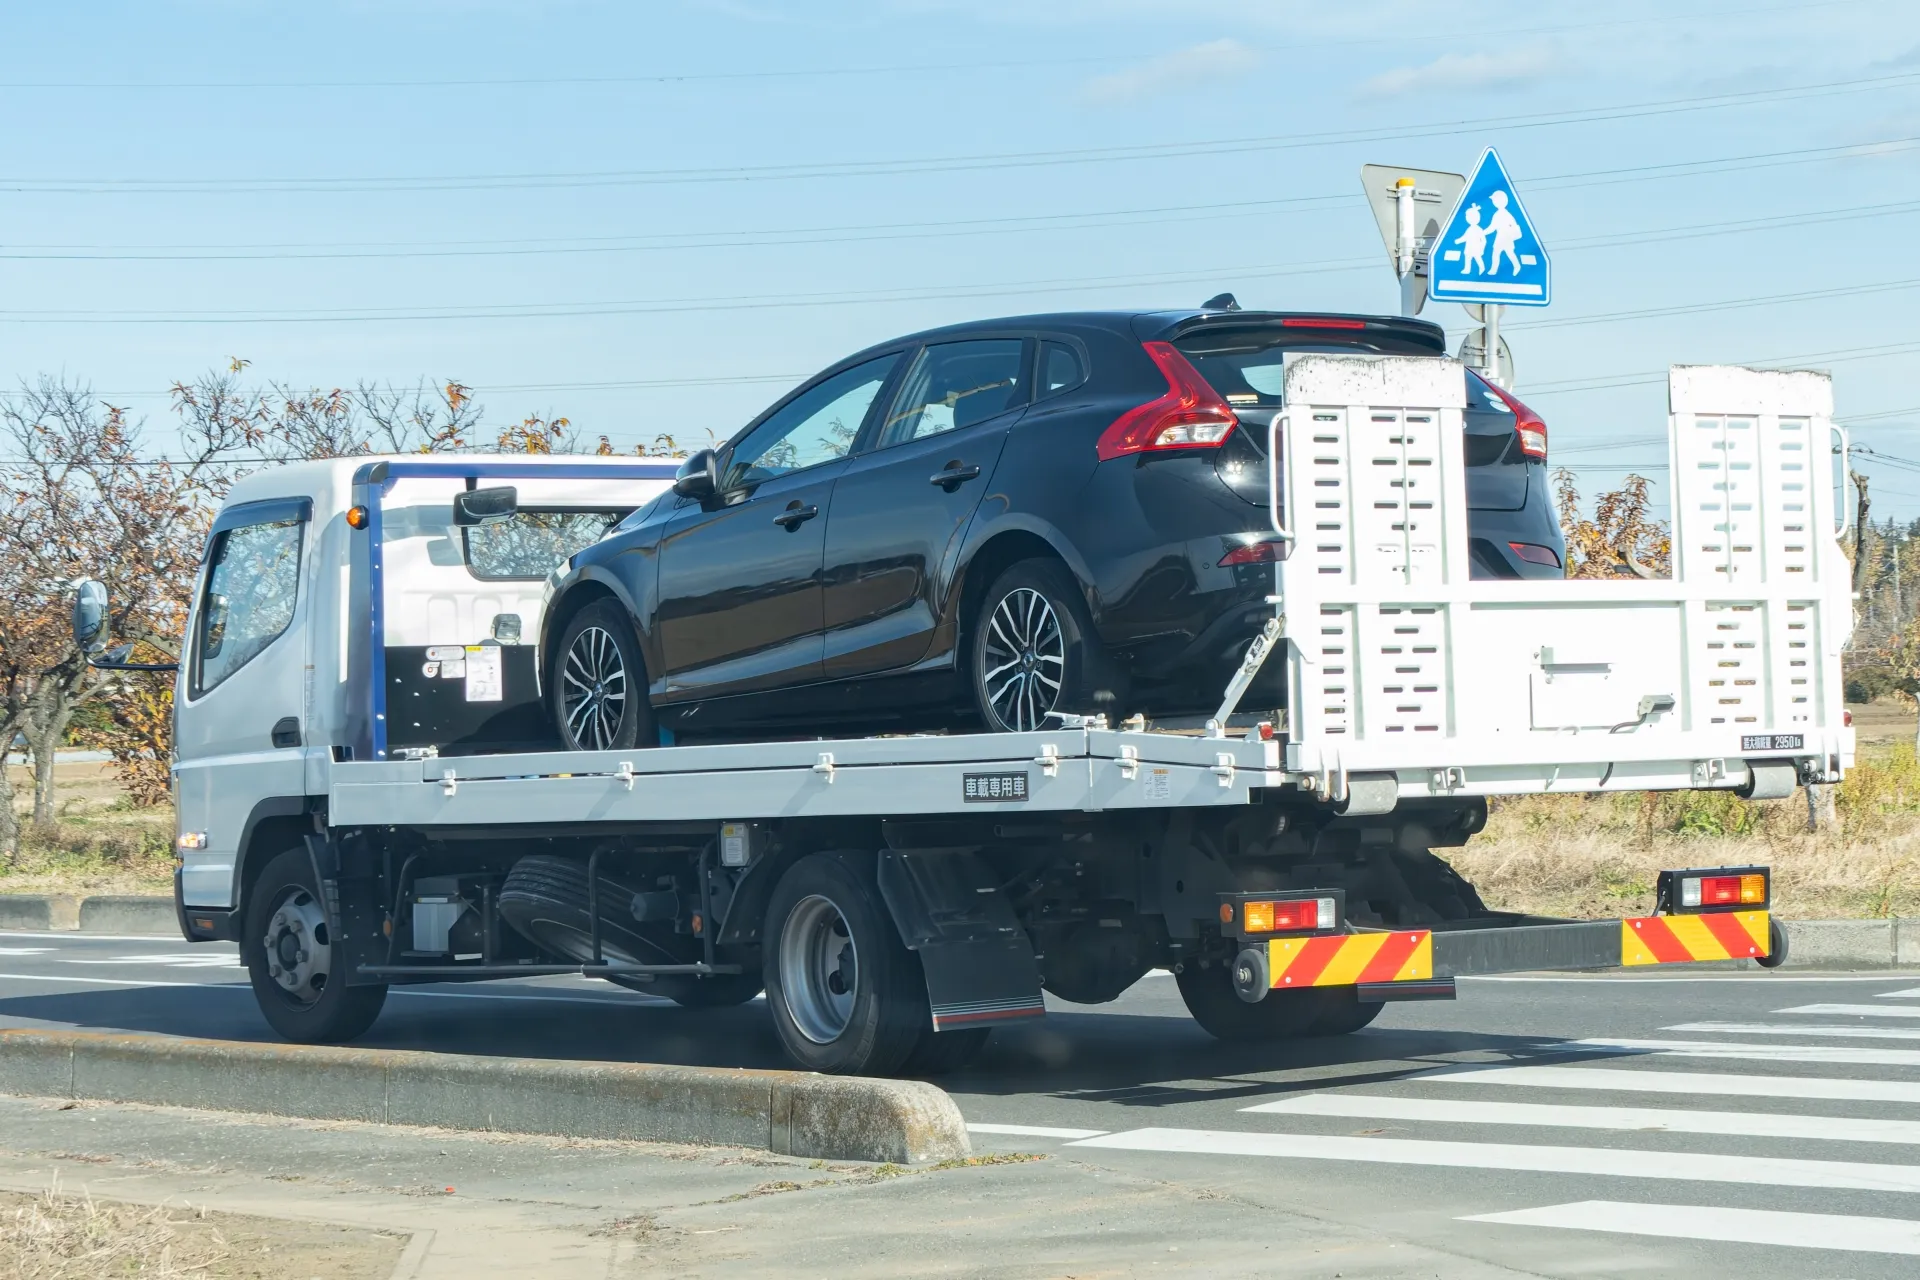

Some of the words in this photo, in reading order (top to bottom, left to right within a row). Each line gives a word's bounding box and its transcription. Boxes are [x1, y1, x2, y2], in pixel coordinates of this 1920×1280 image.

[965, 776, 1026, 798] 車載専用車
